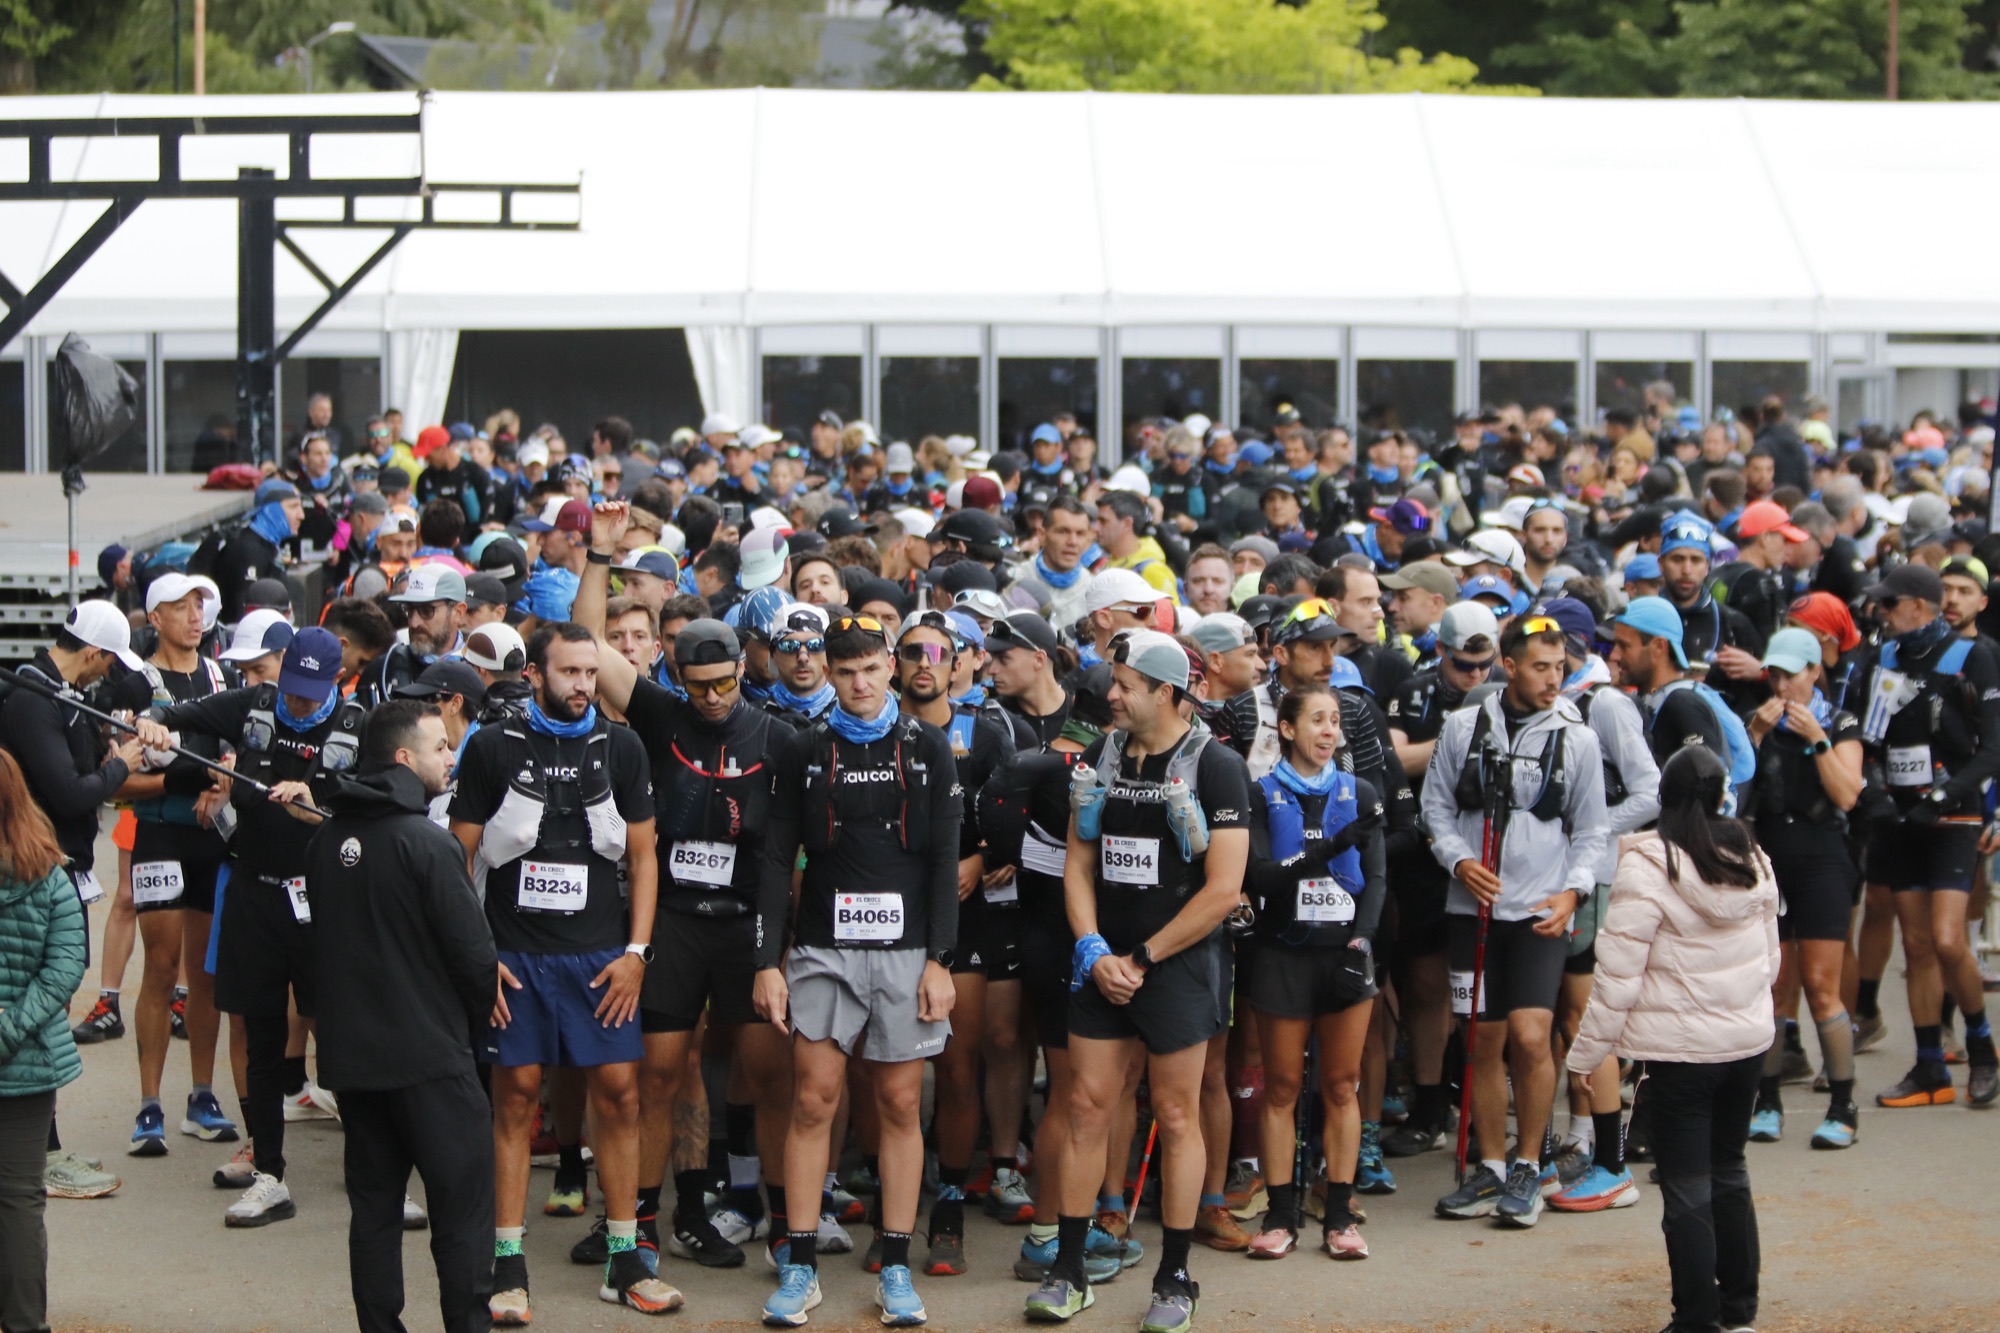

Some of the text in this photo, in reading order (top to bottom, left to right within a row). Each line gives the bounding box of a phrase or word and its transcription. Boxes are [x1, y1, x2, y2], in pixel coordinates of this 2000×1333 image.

[1110, 786, 1160, 799] saucon
[1213, 809, 1240, 822] Ford
[674, 849, 731, 870] B3267
[1105, 850, 1153, 869] B3914
[136, 874, 179, 890] B3613
[524, 876, 583, 896] B3234
[838, 908, 901, 924] B4065
